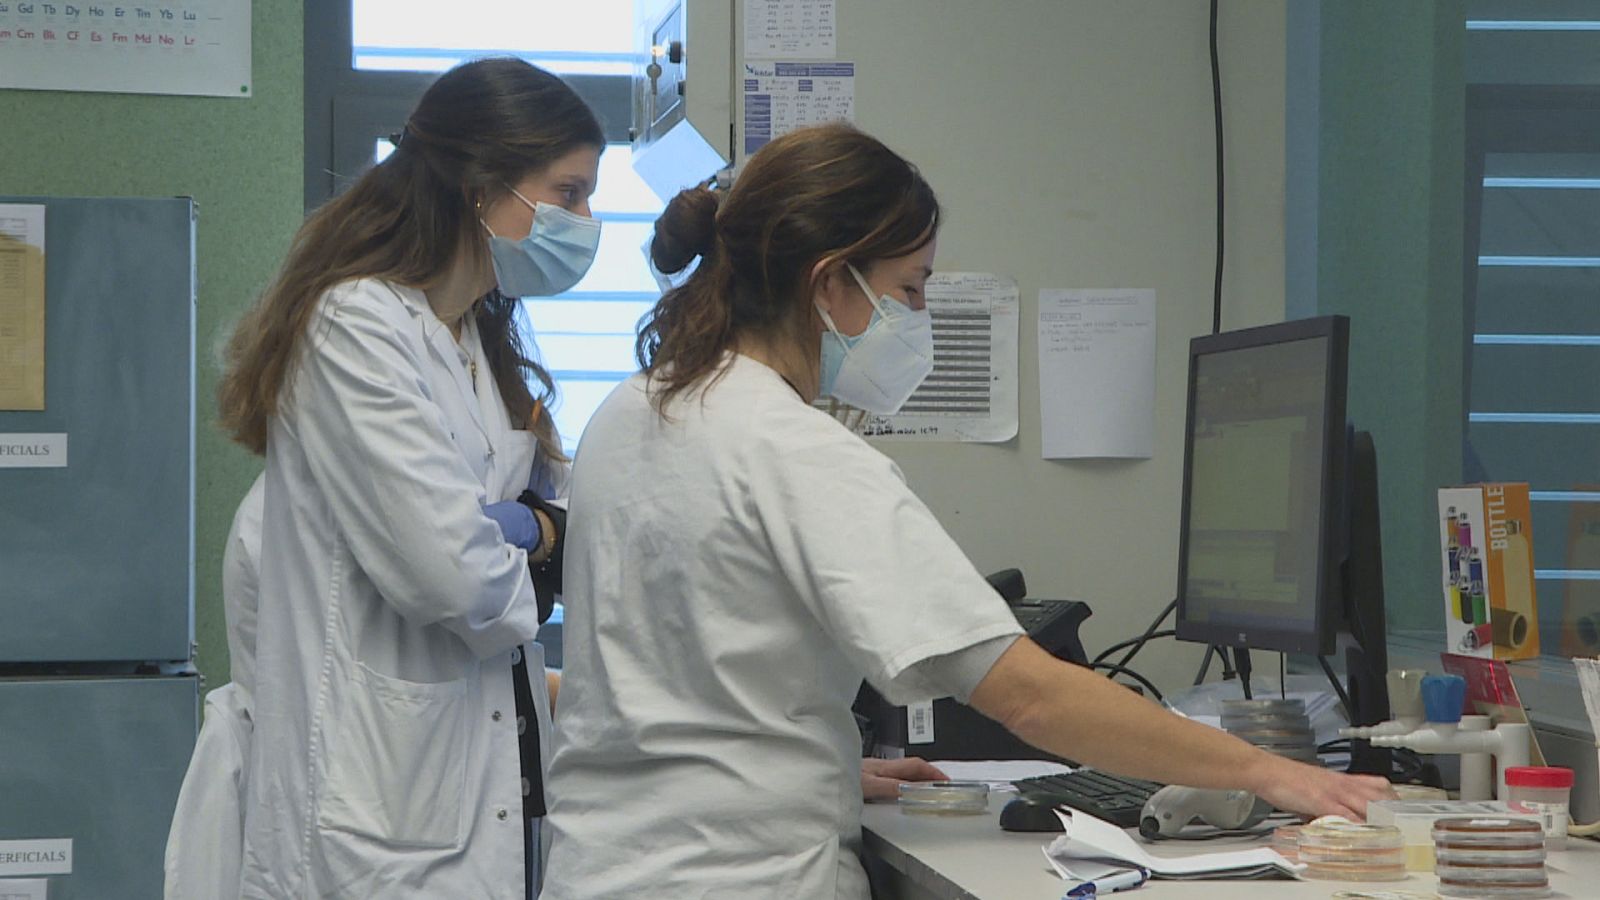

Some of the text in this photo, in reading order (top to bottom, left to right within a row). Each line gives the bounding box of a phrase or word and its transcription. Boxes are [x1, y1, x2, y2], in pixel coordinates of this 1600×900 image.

[18, 3, 34, 14] Gd
[41, 4, 56, 15] Tb
[65, 5, 80, 18] Dy
[89, 6, 104, 17] Ho
[114, 7, 125, 17] Er
[135, 8, 151, 19] Tm
[159, 9, 173, 20] Yb
[183, 10, 196, 21] Lu
[17, 29, 34, 39] Cm
[91, 31, 102, 42] Es
[112, 33, 128, 43] Fm
[135, 34, 151, 44] Md
[158, 35, 174, 45] No
[184, 35, 195, 46] Lr
[1487, 485, 1508, 551] BOTTLE
